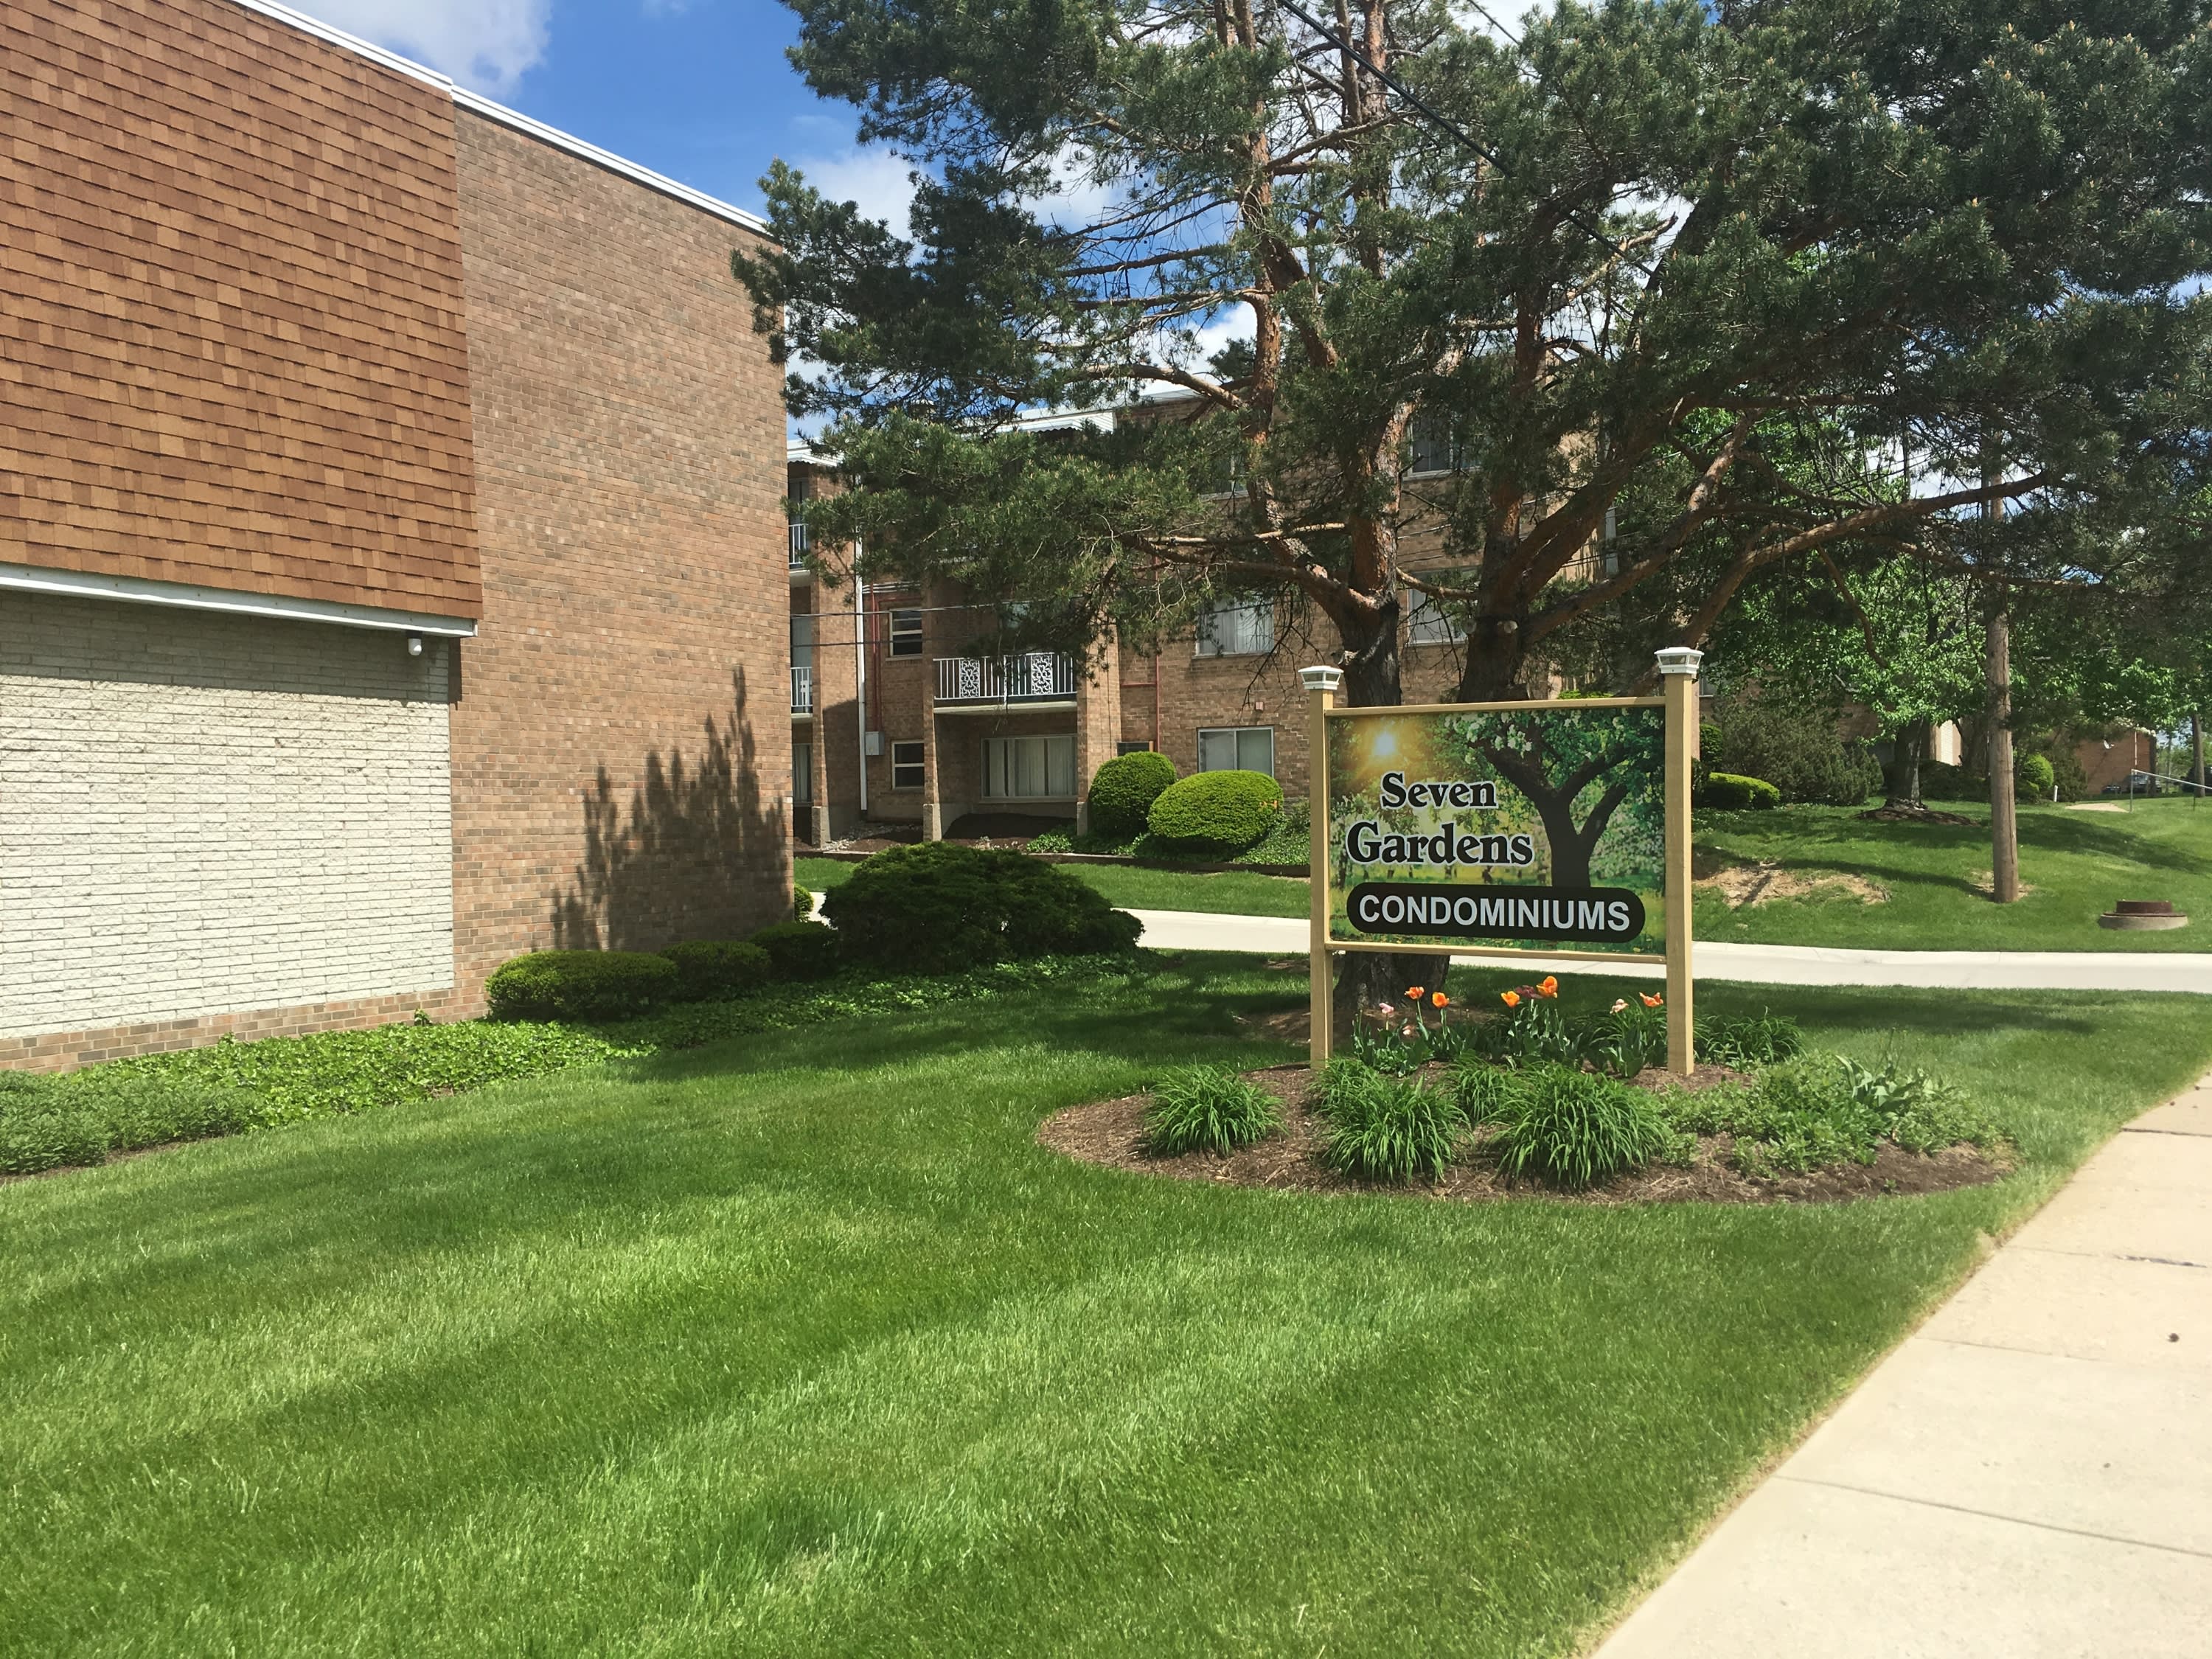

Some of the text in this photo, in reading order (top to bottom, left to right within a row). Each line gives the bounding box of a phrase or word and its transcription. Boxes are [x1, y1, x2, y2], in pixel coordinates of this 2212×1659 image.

[1382, 772, 1496, 809] Seven
[1346, 821, 1534, 865] Gardens
[1359, 894, 1630, 931] CONDOMINIUMS
